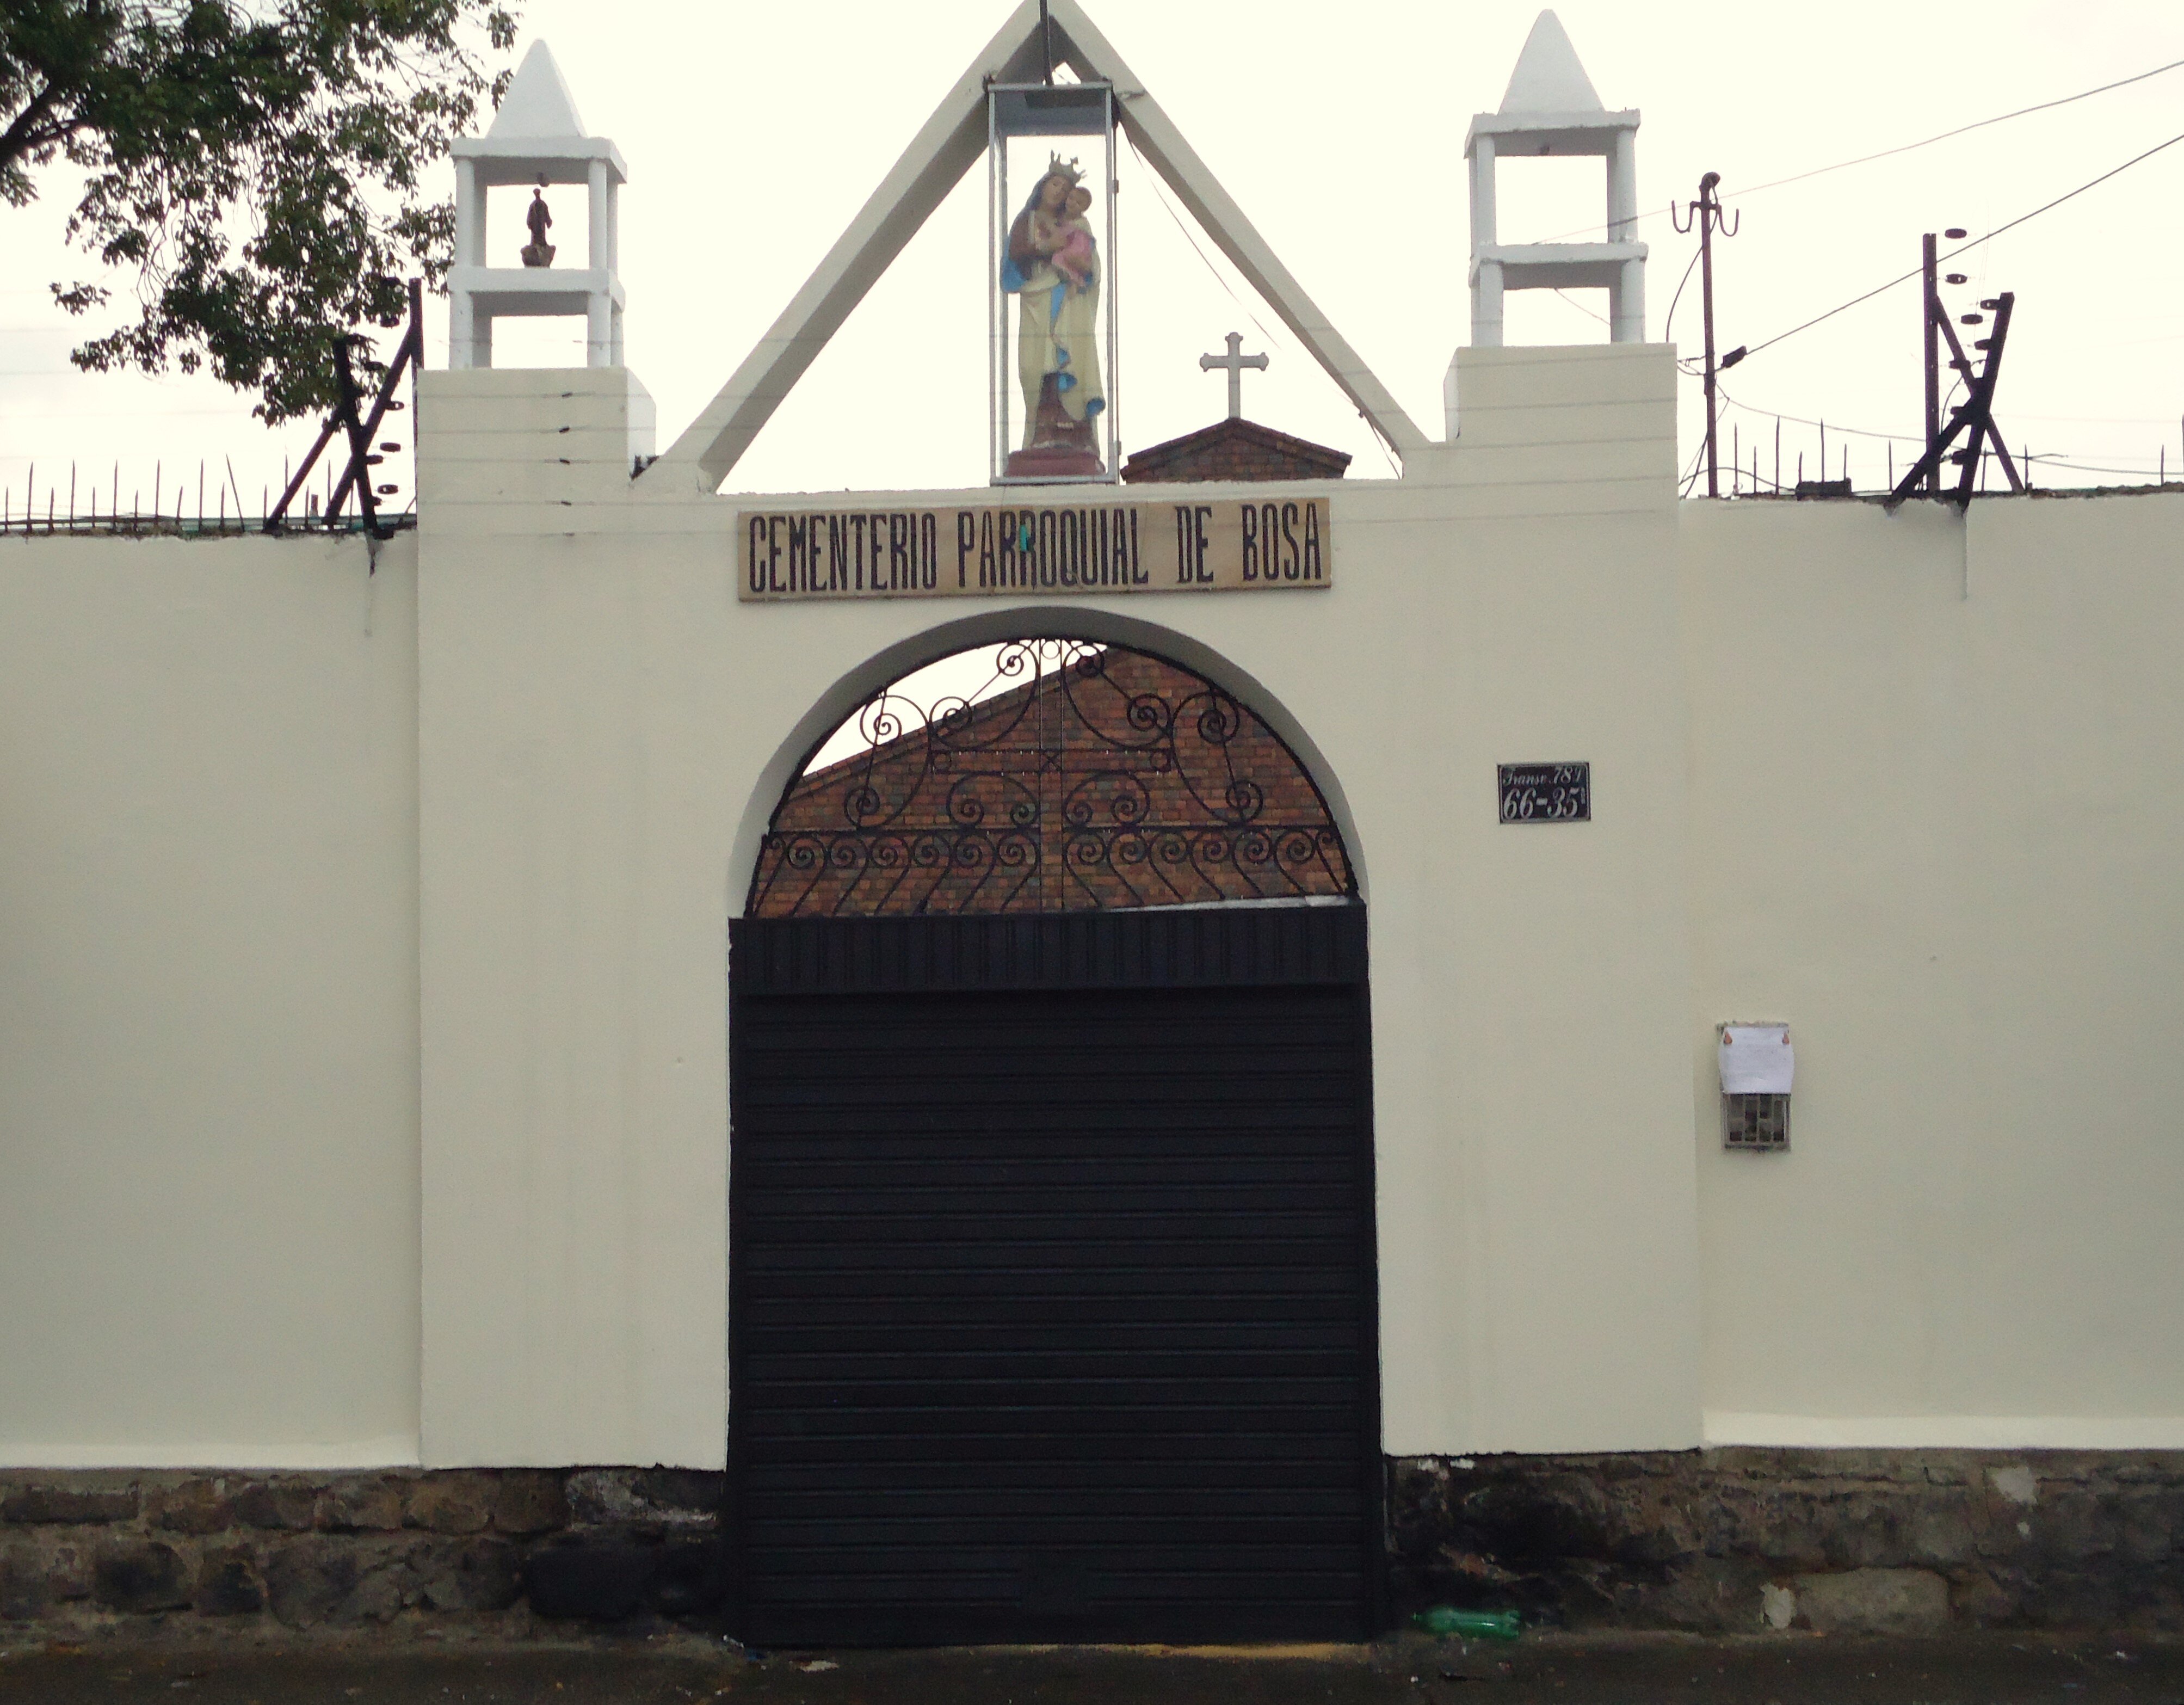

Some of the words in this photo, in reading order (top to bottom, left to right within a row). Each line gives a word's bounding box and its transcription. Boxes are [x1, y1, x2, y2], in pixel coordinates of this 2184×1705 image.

[749, 512, 936, 593] CEMENTERIO
[958, 506, 1149, 589] PARROQUIAL
[1175, 506, 1214, 583] DE
[1241, 502, 1322, 581] BOSA
[1503, 787, 1579, 819] 66-35
